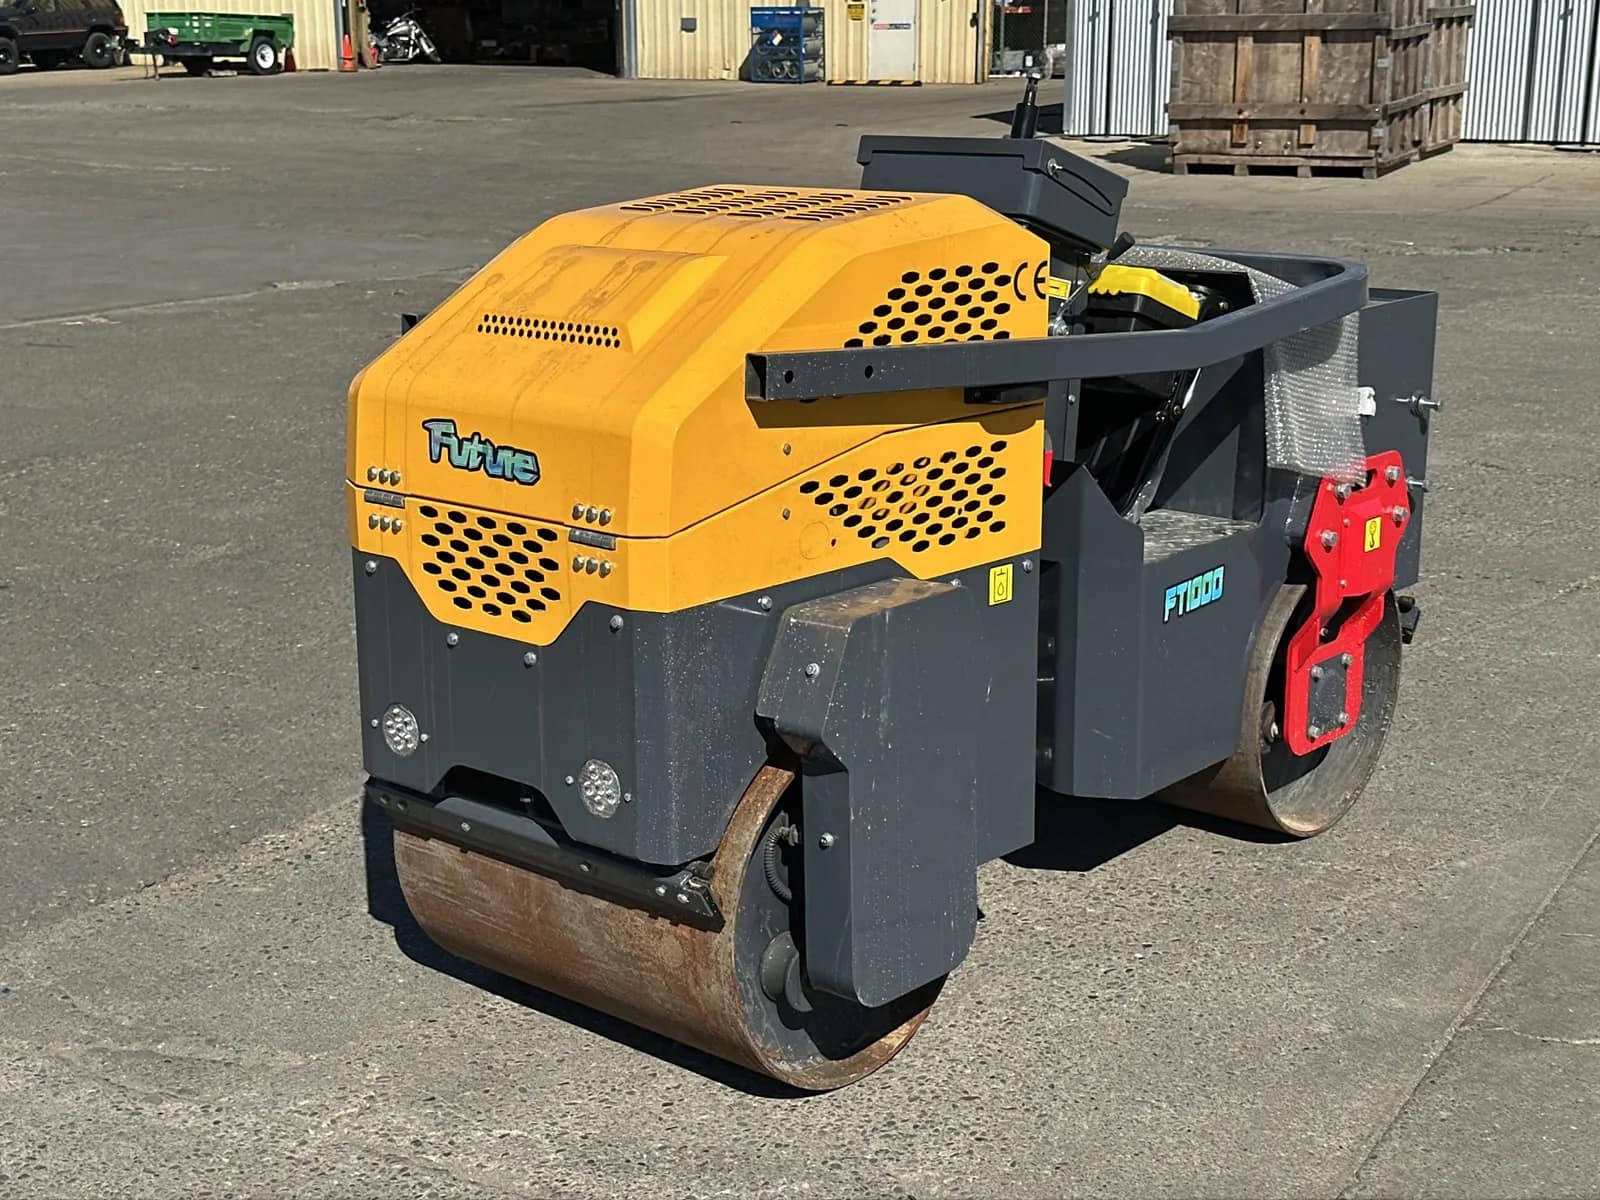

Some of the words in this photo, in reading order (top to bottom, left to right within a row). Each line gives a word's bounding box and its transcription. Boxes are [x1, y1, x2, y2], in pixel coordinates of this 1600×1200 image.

[1014, 260, 1048, 301] CE
[422, 418, 540, 486] Future
[1163, 564, 1225, 624] FT1000
